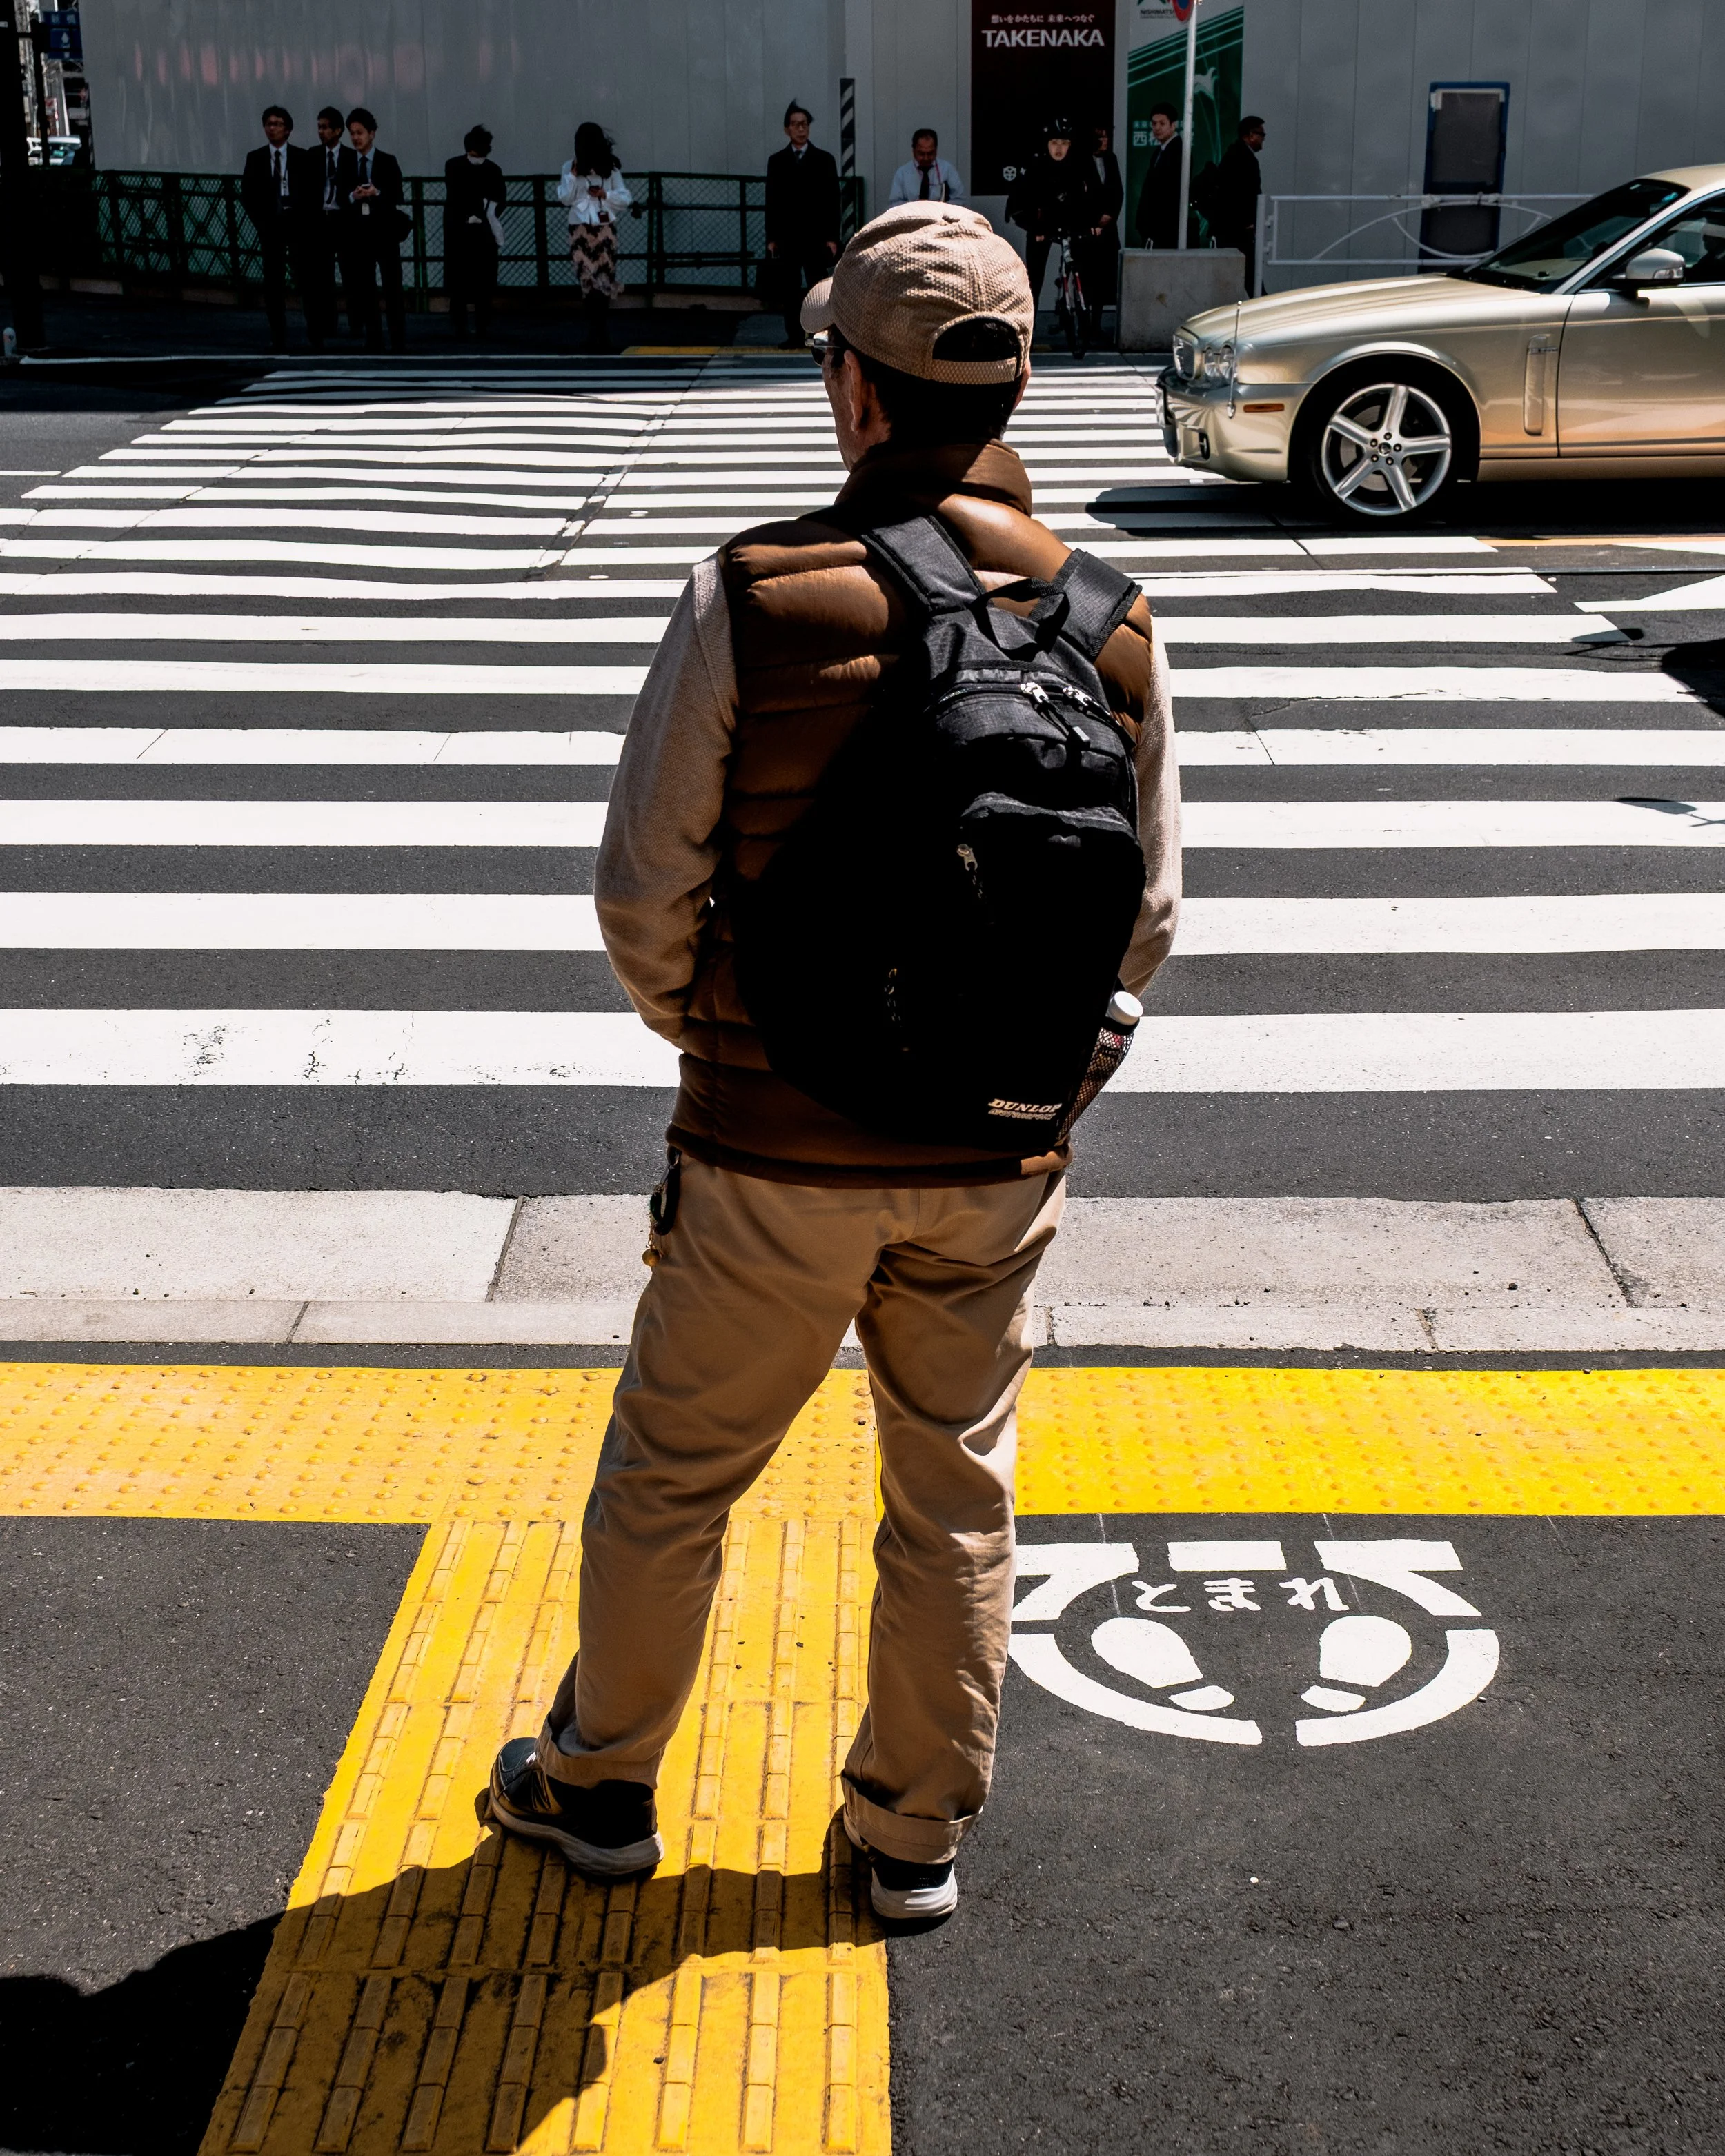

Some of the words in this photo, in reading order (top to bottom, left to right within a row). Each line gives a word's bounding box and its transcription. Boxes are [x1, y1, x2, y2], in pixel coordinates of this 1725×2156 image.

[991, 14, 1044, 24] 想いをかたちに
[1047, 14, 1095, 23] 未来へつなぐ
[981, 29, 1105, 48] TAKENAKA
[988, 1098, 1063, 1113] DUNLOP
[1132, 1577, 1350, 1612] とまれ
